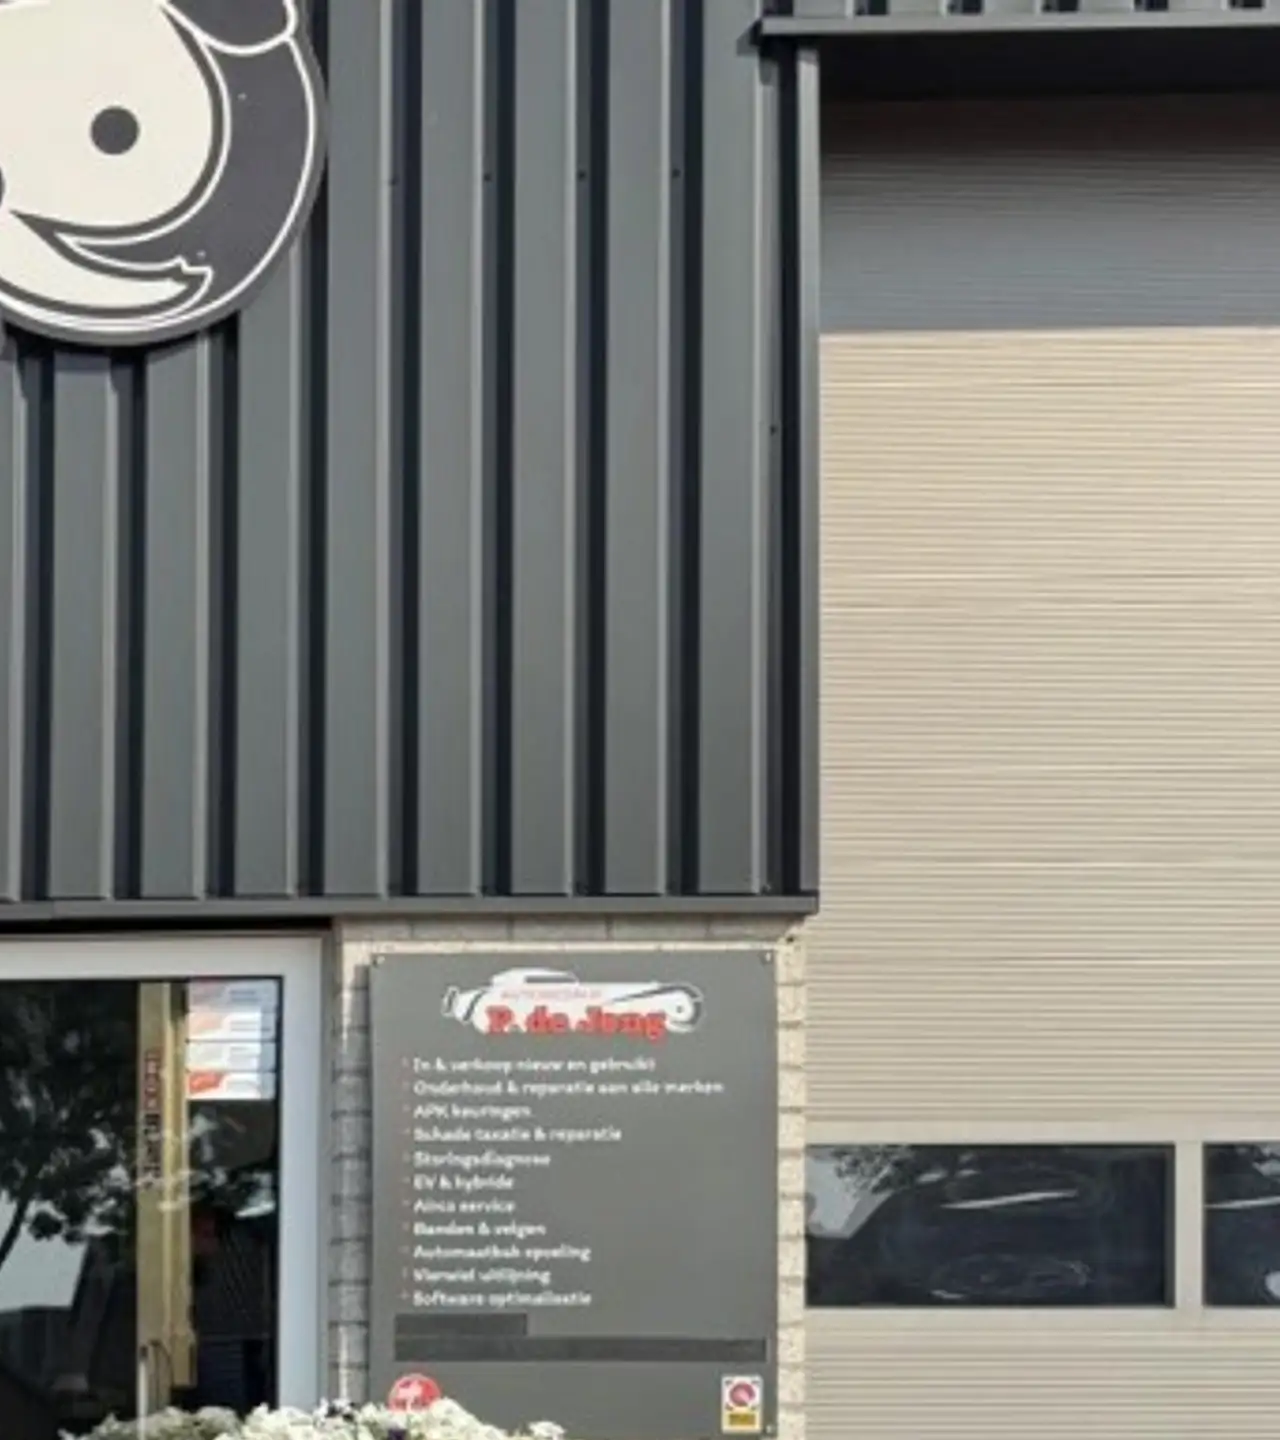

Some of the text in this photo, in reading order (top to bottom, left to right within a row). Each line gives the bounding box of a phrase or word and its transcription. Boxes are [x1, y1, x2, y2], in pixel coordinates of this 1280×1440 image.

[486, 1005, 667, 1042] P. de Jong
[451, 1057, 511, 1076] verkoop
[517, 1058, 564, 1072] nieuw
[567, 1060, 587, 1072] en
[590, 1057, 656, 1074] gebruikt
[414, 1080, 502, 1096] Onderhoud
[507, 1080, 518, 1096] &
[522, 1081, 595, 1099] reparatie
[597, 1083, 629, 1094] aan
[664, 1080, 724, 1095] merken
[414, 1103, 532, 1123] APK keuringen
[414, 1126, 623, 1144] Schade taxatie & reparatie
[414, 1150, 551, 1170] Storingsdiagnose
[414, 1173, 514, 1194] EV & hybride
[459, 1198, 515, 1213] service
[414, 1220, 547, 1239] Banden & velgen
[414, 1243, 592, 1262] Automaatbak spoeling
[478, 1267, 551, 1286] uitlijning
[414, 1290, 592, 1308] Software optimalisatie
